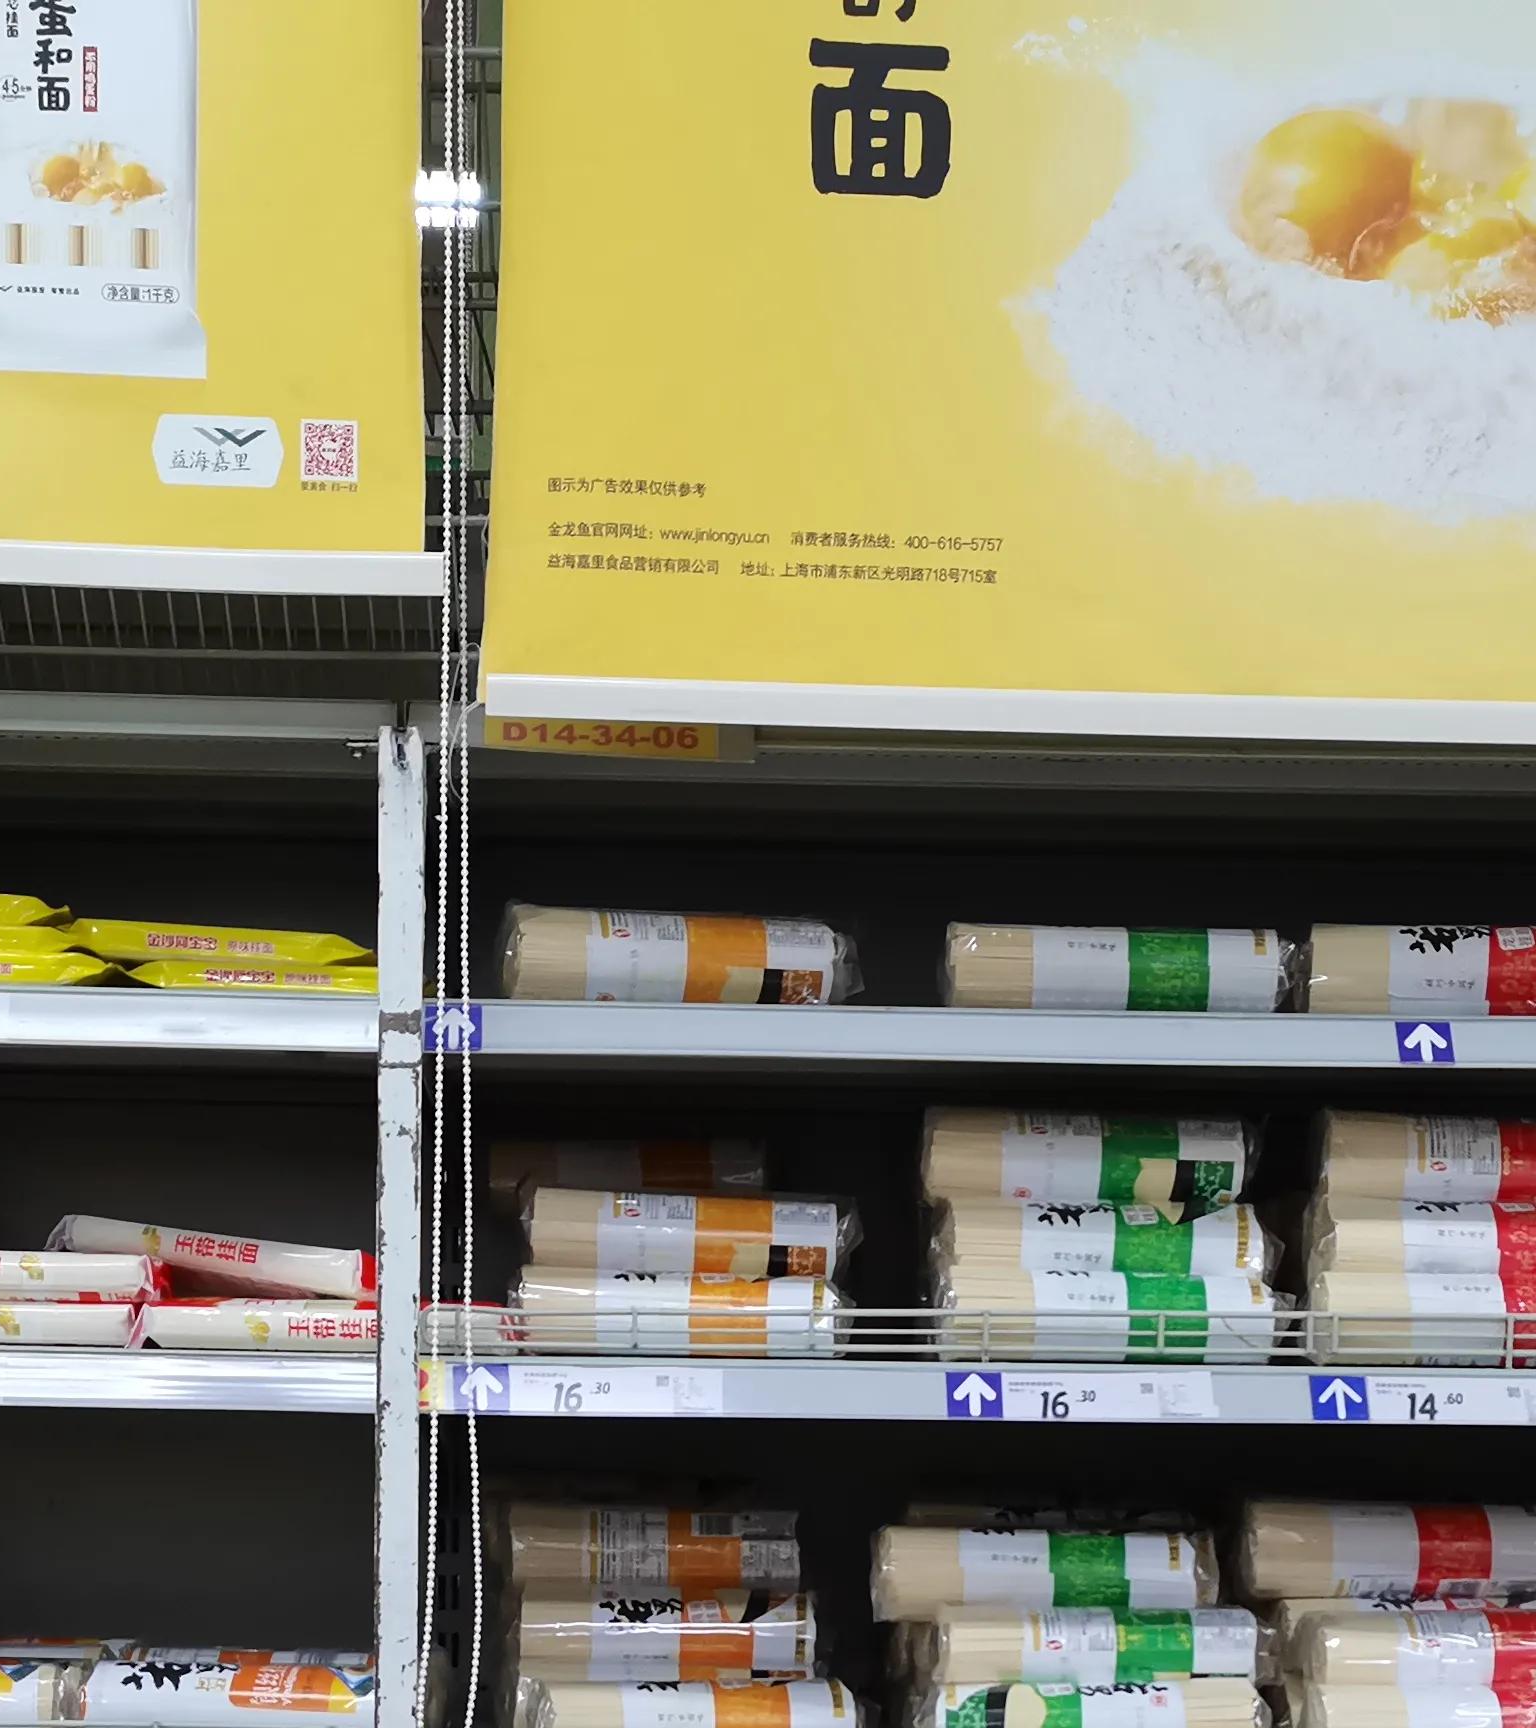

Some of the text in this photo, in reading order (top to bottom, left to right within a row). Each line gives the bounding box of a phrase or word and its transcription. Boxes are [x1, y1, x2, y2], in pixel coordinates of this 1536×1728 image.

[809, 0, 951, 198] 面
[169, 450, 250, 472] 益海嘉里
[501, 723, 700, 751] D14-34-06
[175, 1234, 260, 1264] 玉带挂面
